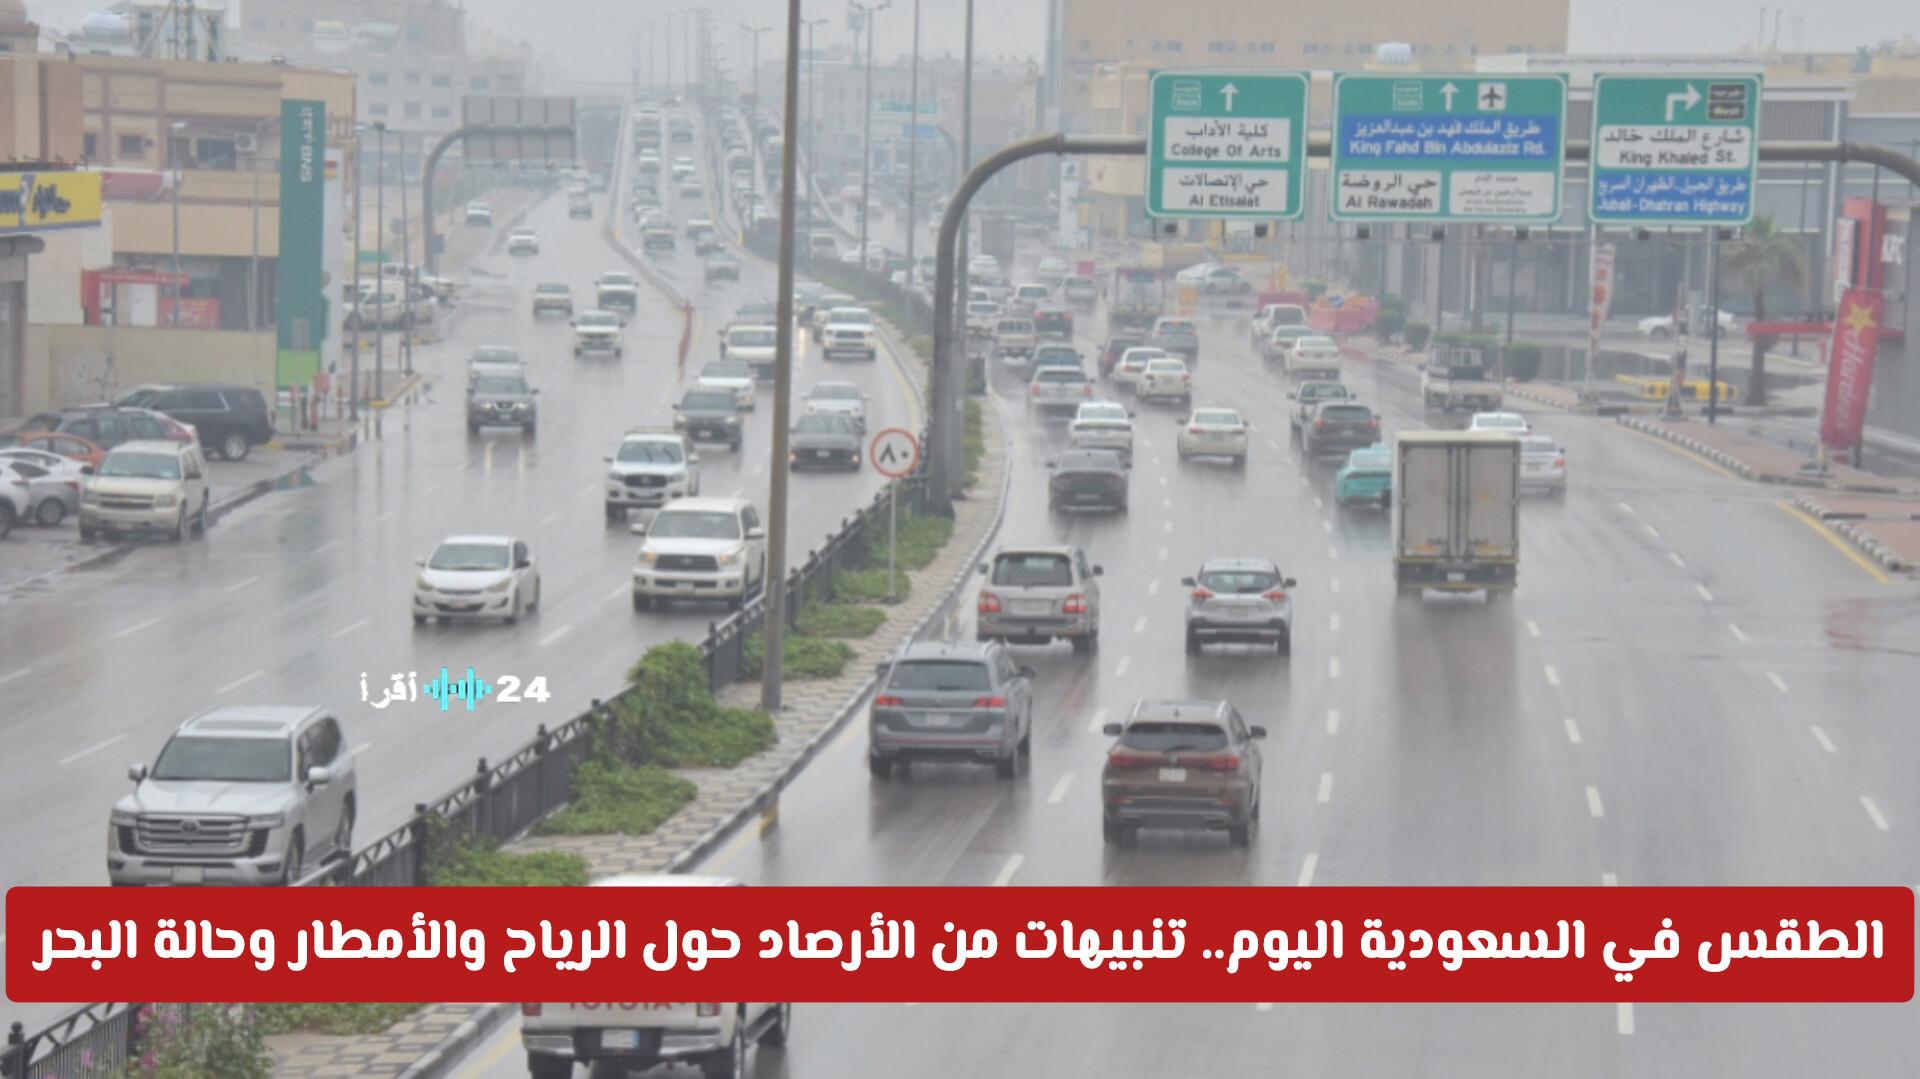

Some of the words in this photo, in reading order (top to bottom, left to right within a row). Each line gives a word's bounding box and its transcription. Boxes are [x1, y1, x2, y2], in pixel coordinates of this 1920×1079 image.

[1237, 123, 1269, 141] كلية
[1416, 121, 1434, 138] بن
[1437, 119, 1462, 138] فهد
[1464, 118, 1501, 134] الملك
[1502, 119, 1541, 139] طريق
[1604, 128, 1643, 142] خالد
[1650, 128, 1696, 143] الملك
[1701, 129, 1744, 150] شارع
[1171, 143, 1219, 159] College
[1226, 144, 1243, 157] Of
[1249, 145, 1282, 158] Arts
[1349, 140, 1381, 157] King
[1385, 140, 1420, 154] Fahd
[1423, 140, 1447, 154] Bin
[1450, 140, 1520, 155] Abdulaziz
[1523, 141, 1546, 155] Rd.
[299, 145, 313, 183] SNB
[1619, 151, 1652, 167] King
[1658, 151, 1709, 165] Khaled
[1715, 150, 1737, 163] St.
[1245, 178, 1269, 194] حي
[1342, 173, 1402, 191] الروضة
[1407, 179, 1437, 196] حي
[1715, 176, 1747, 197] طريق
[1188, 194, 1204, 207] Al
[1209, 194, 1260, 208] Etisalat
[1346, 195, 1361, 208] Al
[1368, 195, 1433, 208] Rawadah
[1692, 198, 1746, 217] Highway
[880, 443, 908, 463] ٨٠
